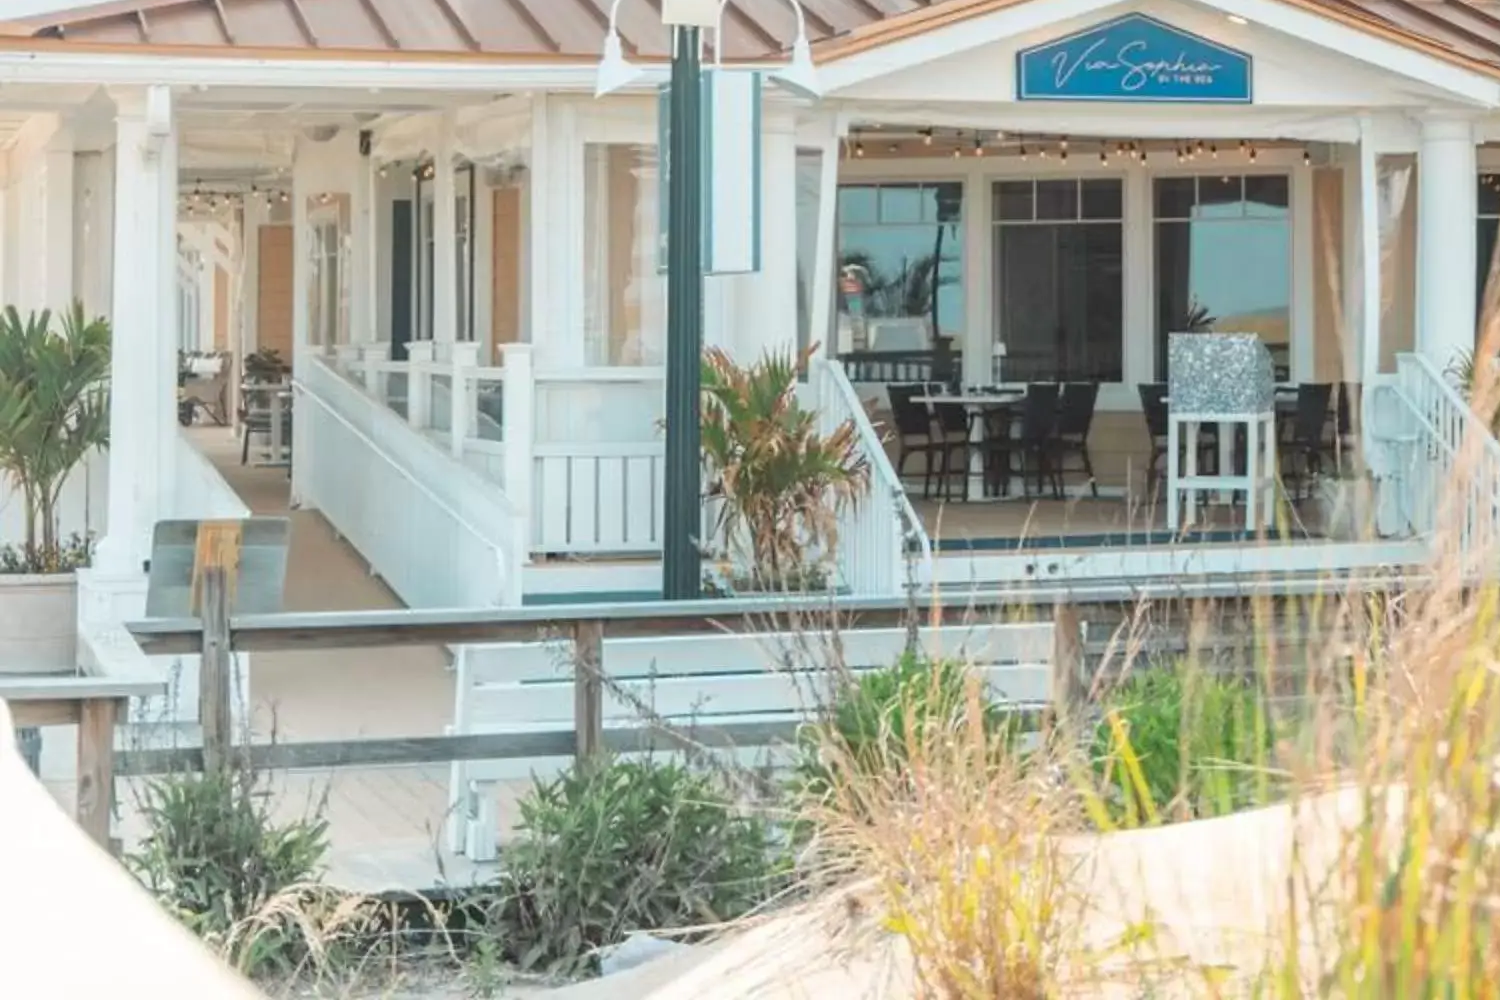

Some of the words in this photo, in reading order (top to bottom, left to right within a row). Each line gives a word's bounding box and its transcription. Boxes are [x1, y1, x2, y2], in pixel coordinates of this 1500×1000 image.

[1052, 38, 1120, 88] Via
[1117, 41, 1222, 90] Sophia
[1174, 74, 1191, 84] THE
